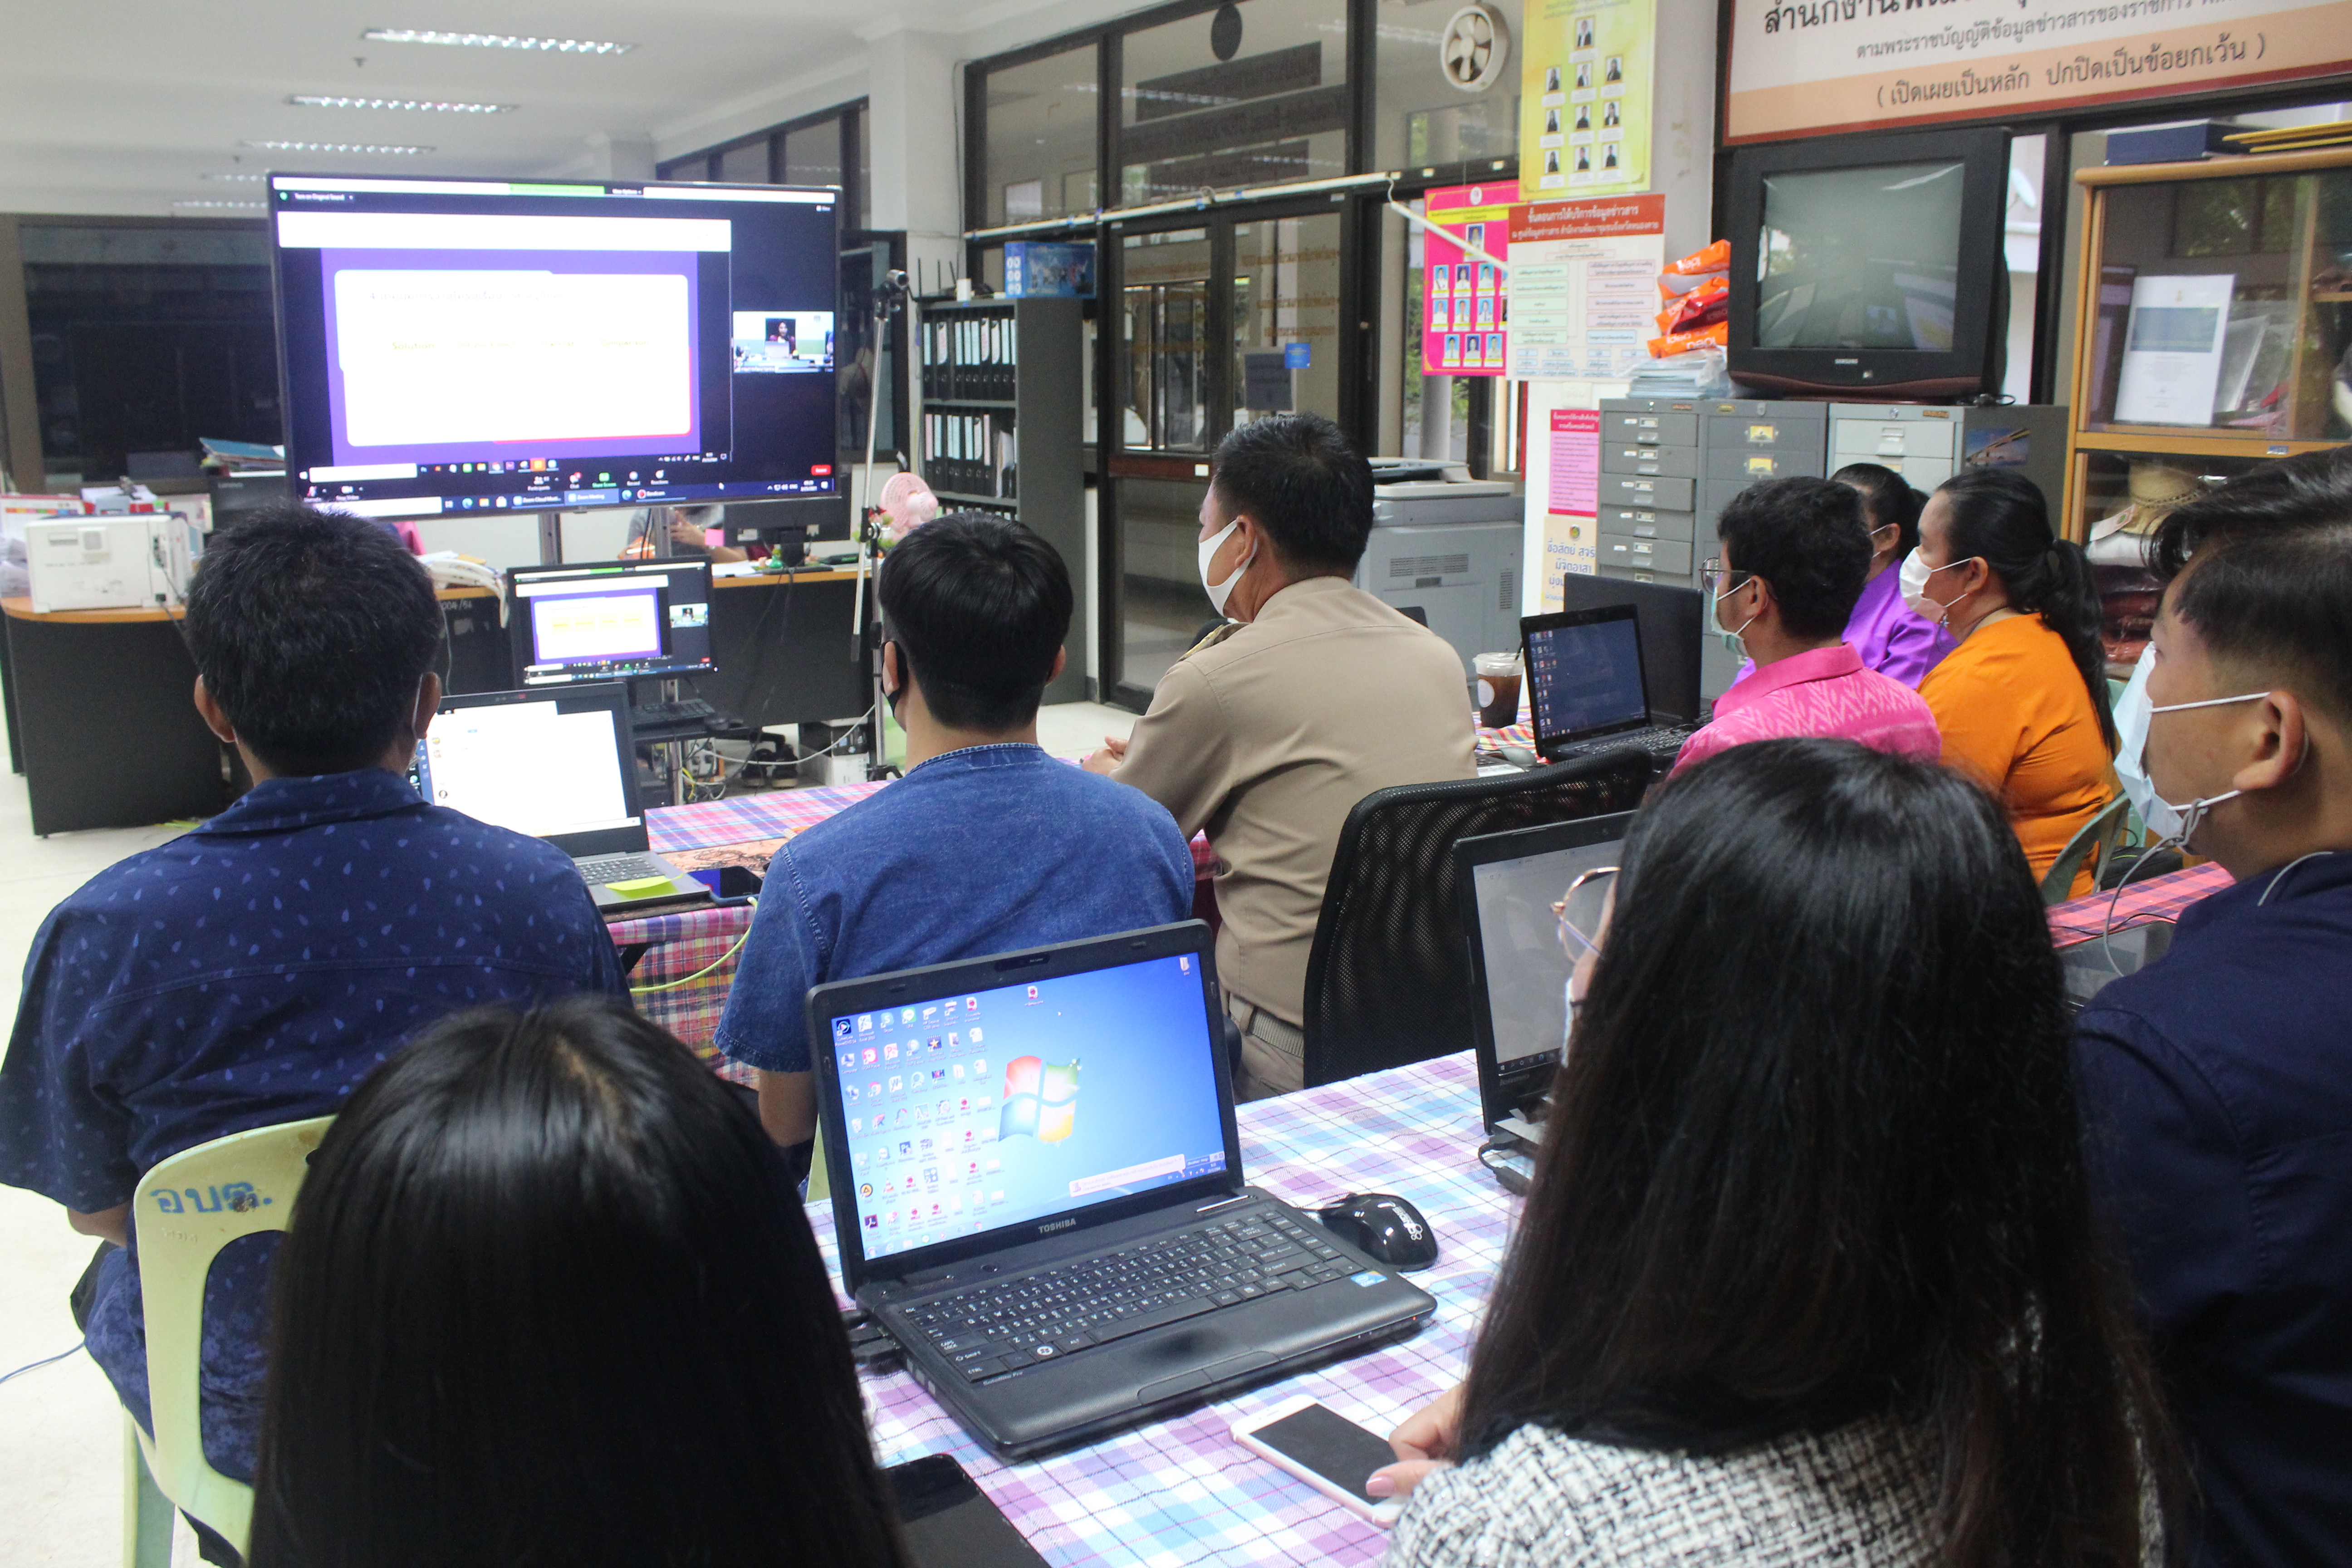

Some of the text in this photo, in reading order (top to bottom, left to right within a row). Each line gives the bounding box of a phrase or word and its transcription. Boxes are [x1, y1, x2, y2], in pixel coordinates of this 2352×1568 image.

[1891, 64, 2029, 105] เปิดเผยเป็นหลัก
[392, 341, 435, 350] Solution
[600, 339, 650, 348] Comparison
[1578, 545, 1596, 560] สุจริ
[1038, 1217, 1077, 1234] TOSHIBA
